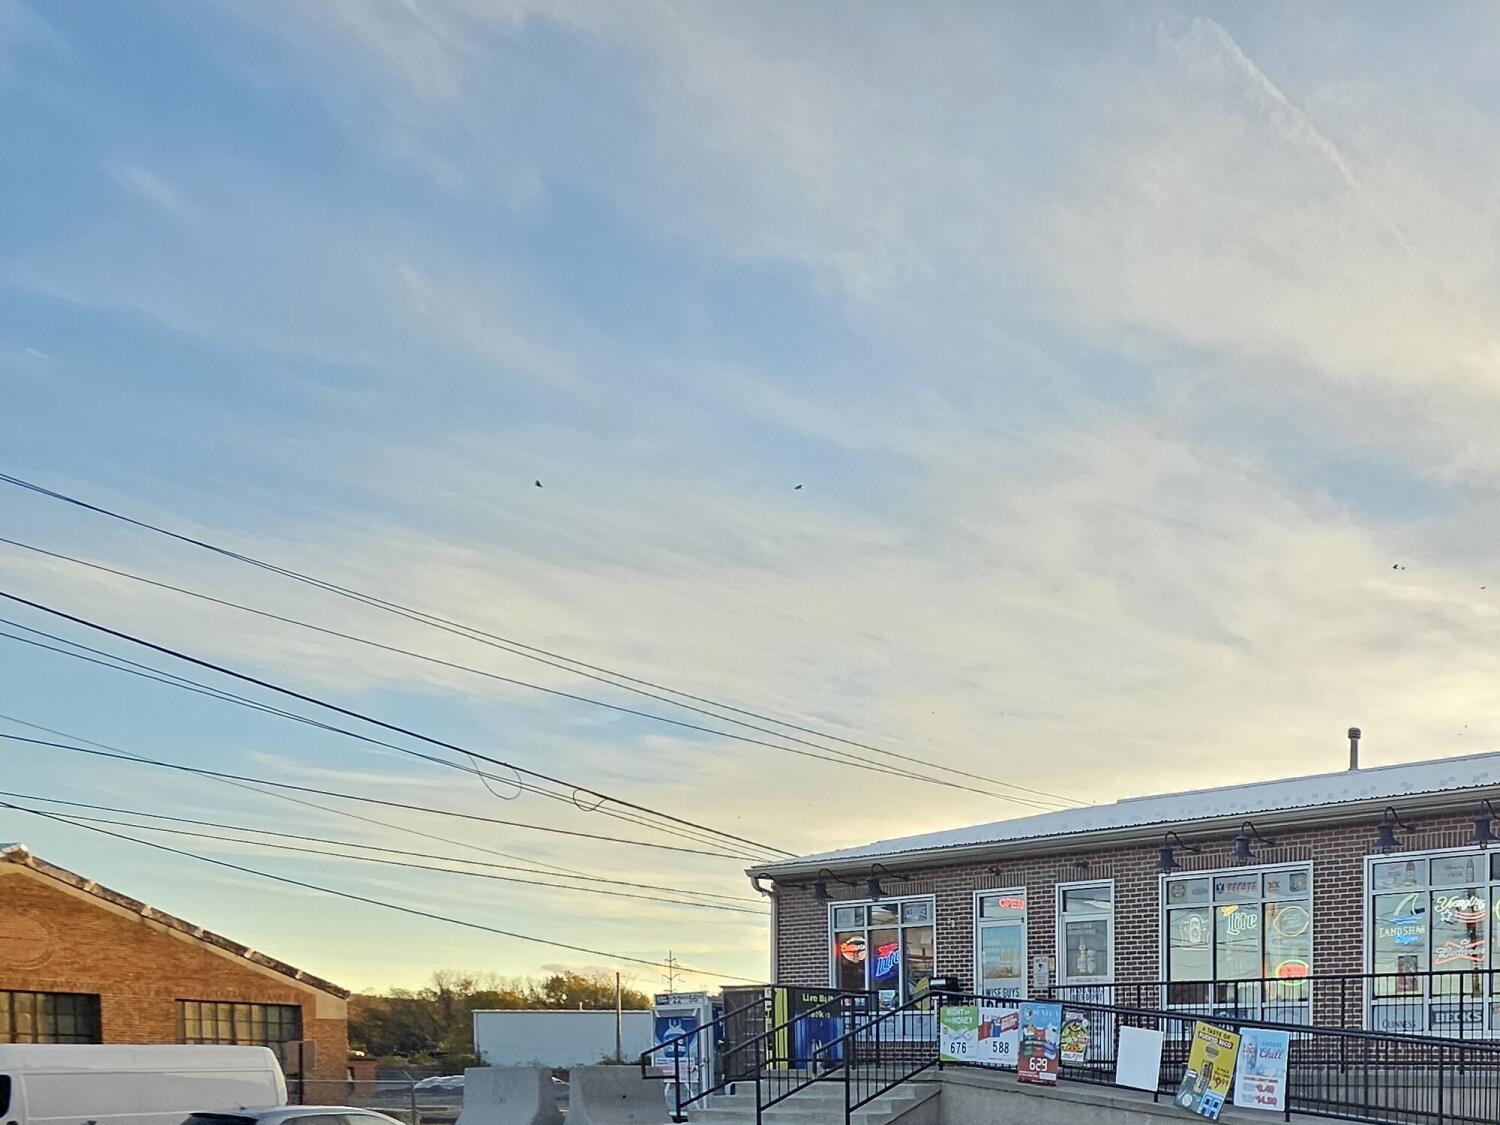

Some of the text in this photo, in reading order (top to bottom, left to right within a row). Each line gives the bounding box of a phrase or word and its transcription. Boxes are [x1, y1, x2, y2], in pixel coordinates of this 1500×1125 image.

[999, 898, 1025, 909] OPEN
[1207, 1028, 1222, 1037] TASTE
[951, 1042, 967, 1054] 676
[992, 1041, 1010, 1054] 588
[1260, 1048, 1282, 1060] Chill
[1029, 1057, 1048, 1071] 629
